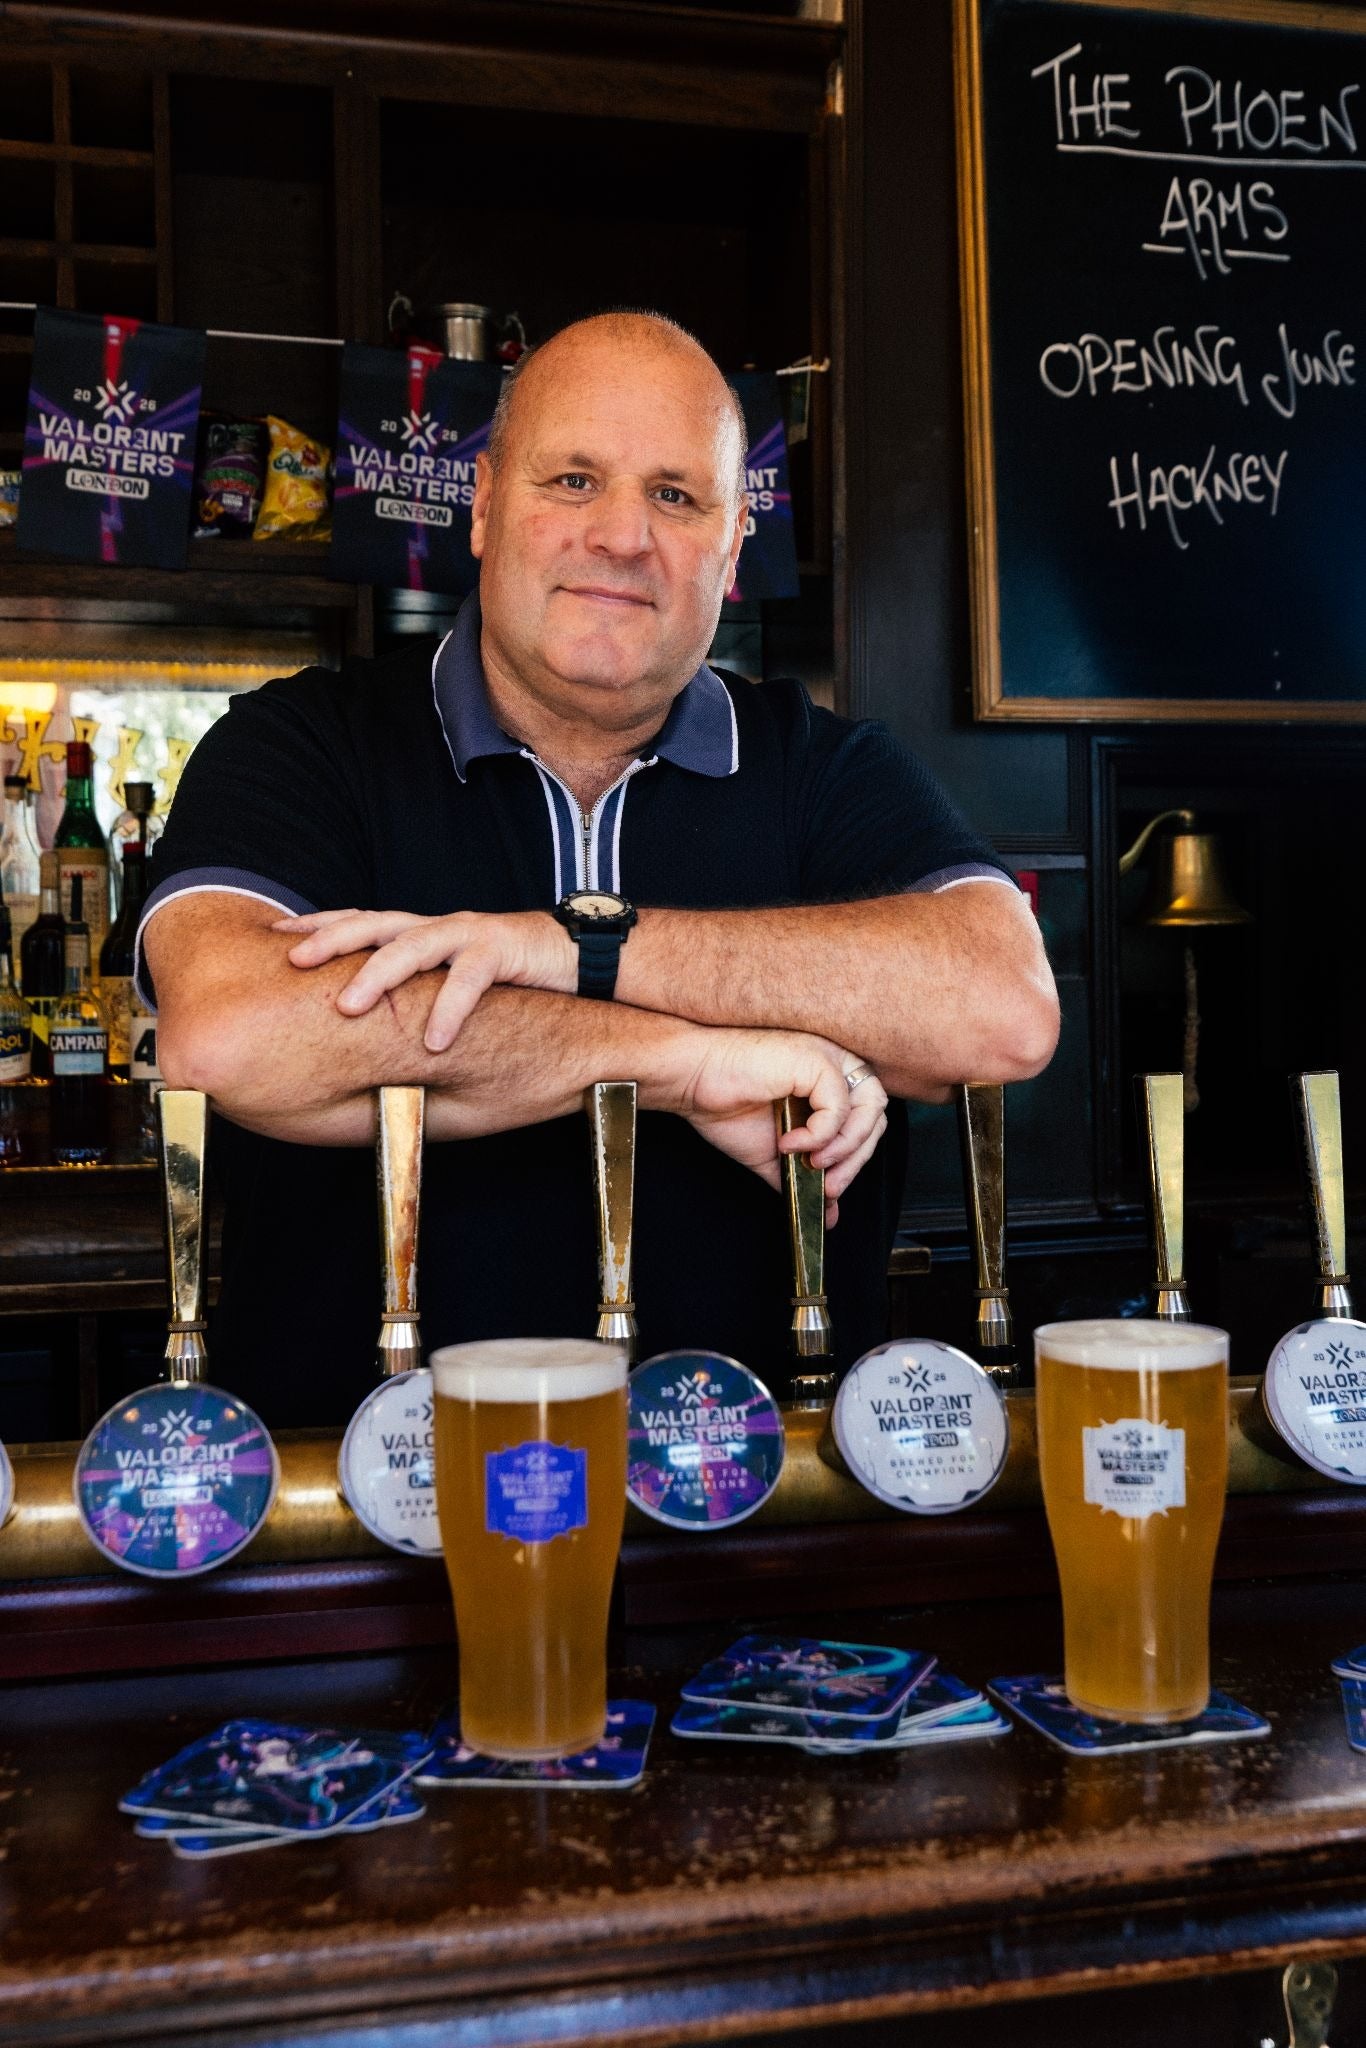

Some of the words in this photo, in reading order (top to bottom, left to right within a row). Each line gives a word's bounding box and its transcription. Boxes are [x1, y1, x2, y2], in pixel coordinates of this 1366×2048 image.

[1031, 42, 1140, 141] THE
[1165, 65, 1360, 153] PHOEN
[1160, 176, 1289, 281] ARMS
[1040, 325, 1249, 407] OPENING
[1261, 323, 1356, 419] JUNE
[73, 388, 92, 402] 20
[139, 398, 157, 412] 26
[380, 419, 398, 433] 20
[441, 429, 459, 442] 26
[43, 438, 175, 477] MASTERS
[70, 471, 145, 496] LONDON
[354, 468, 476, 506] MASTERS
[746, 468, 778, 490] NT
[1108, 444, 1288, 550] HACKNEY
[379, 501, 448, 524] LONDON
[51, 1034, 107, 1051] CAMPARI
[1313, 1353, 1325, 1361] 20
[888, 1375, 900, 1384] 20
[934, 1373, 946, 1381] 26
[878, 1411, 972, 1432] MASTERS
[648, 1423, 747, 1446] MASTERS
[1331, 1442, 1366, 1450] CHAM
[122, 1462, 233, 1488] MASTERS
